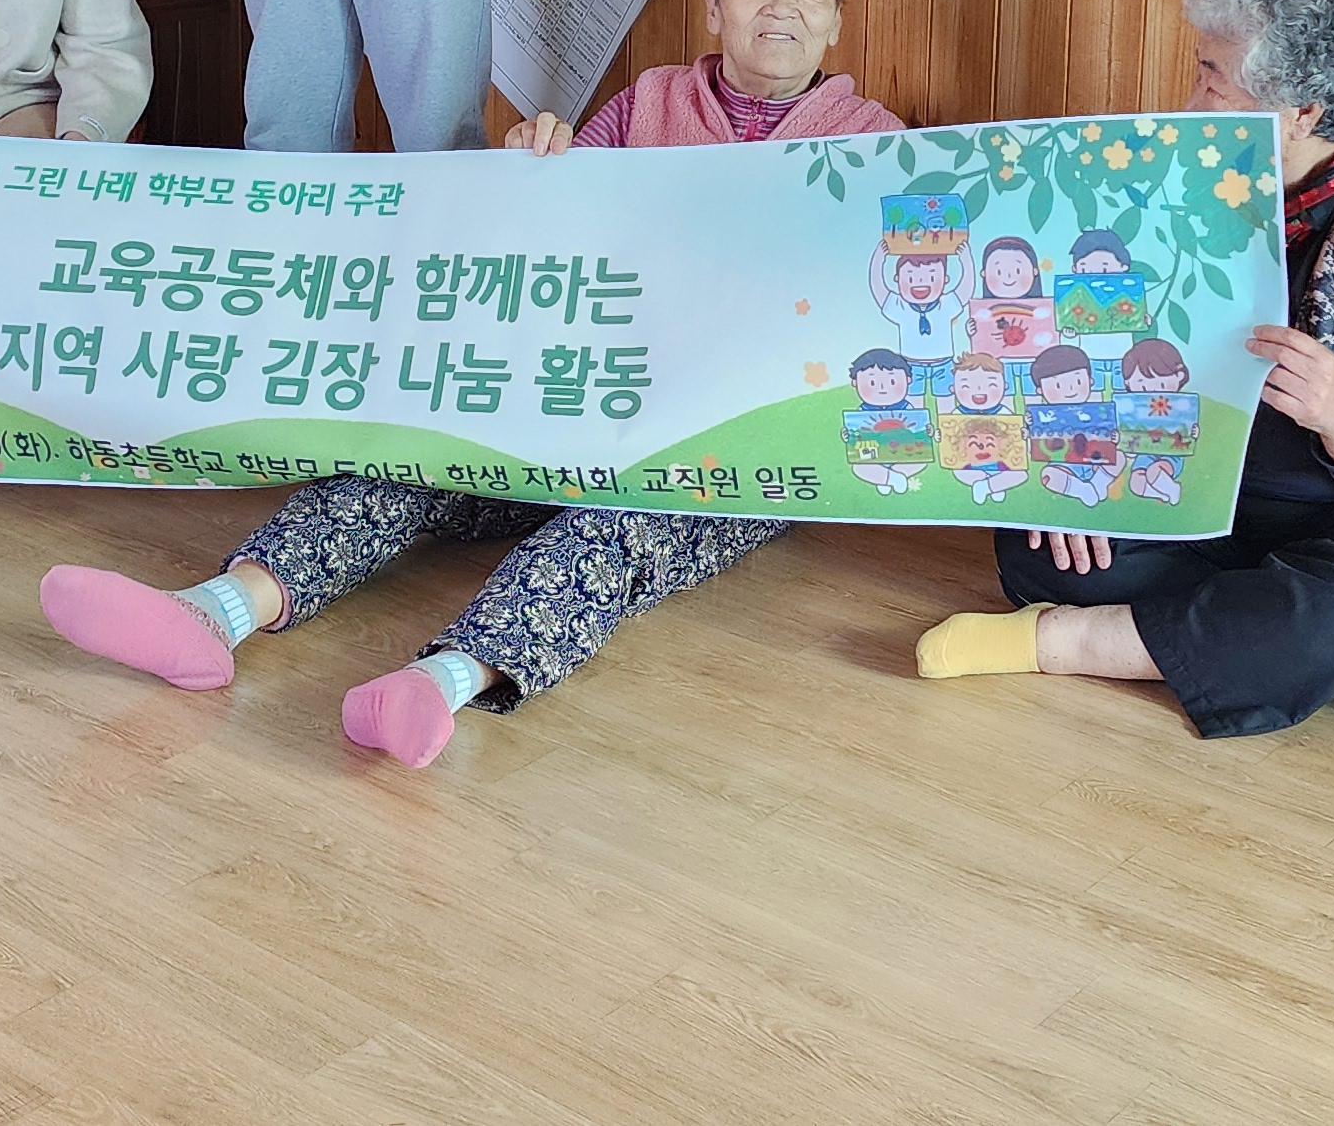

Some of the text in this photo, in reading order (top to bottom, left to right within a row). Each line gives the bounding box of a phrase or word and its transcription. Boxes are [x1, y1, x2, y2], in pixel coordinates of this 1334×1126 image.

[3, 164, 67, 199] 그린
[75, 170, 136, 204] 나래
[148, 173, 235, 208] 학부모
[244, 178, 334, 217] 동아리
[344, 182, 405, 218] 주관
[38, 237, 643, 326] 교육공동체와 함께하는
[122, 329, 243, 404] 사랑
[264, 336, 380, 412] 김장
[397, 342, 513, 412] 나눔
[533, 344, 653, 420] 활동
[67, 436, 233, 474] 하동초등학교
[236, 452, 319, 481] 학부모
[446, 463, 511, 492] 학생
[521, 464, 629, 494] 자치회,
[642, 467, 742, 499] 교직원
[754, 466, 822, 501] 일동
